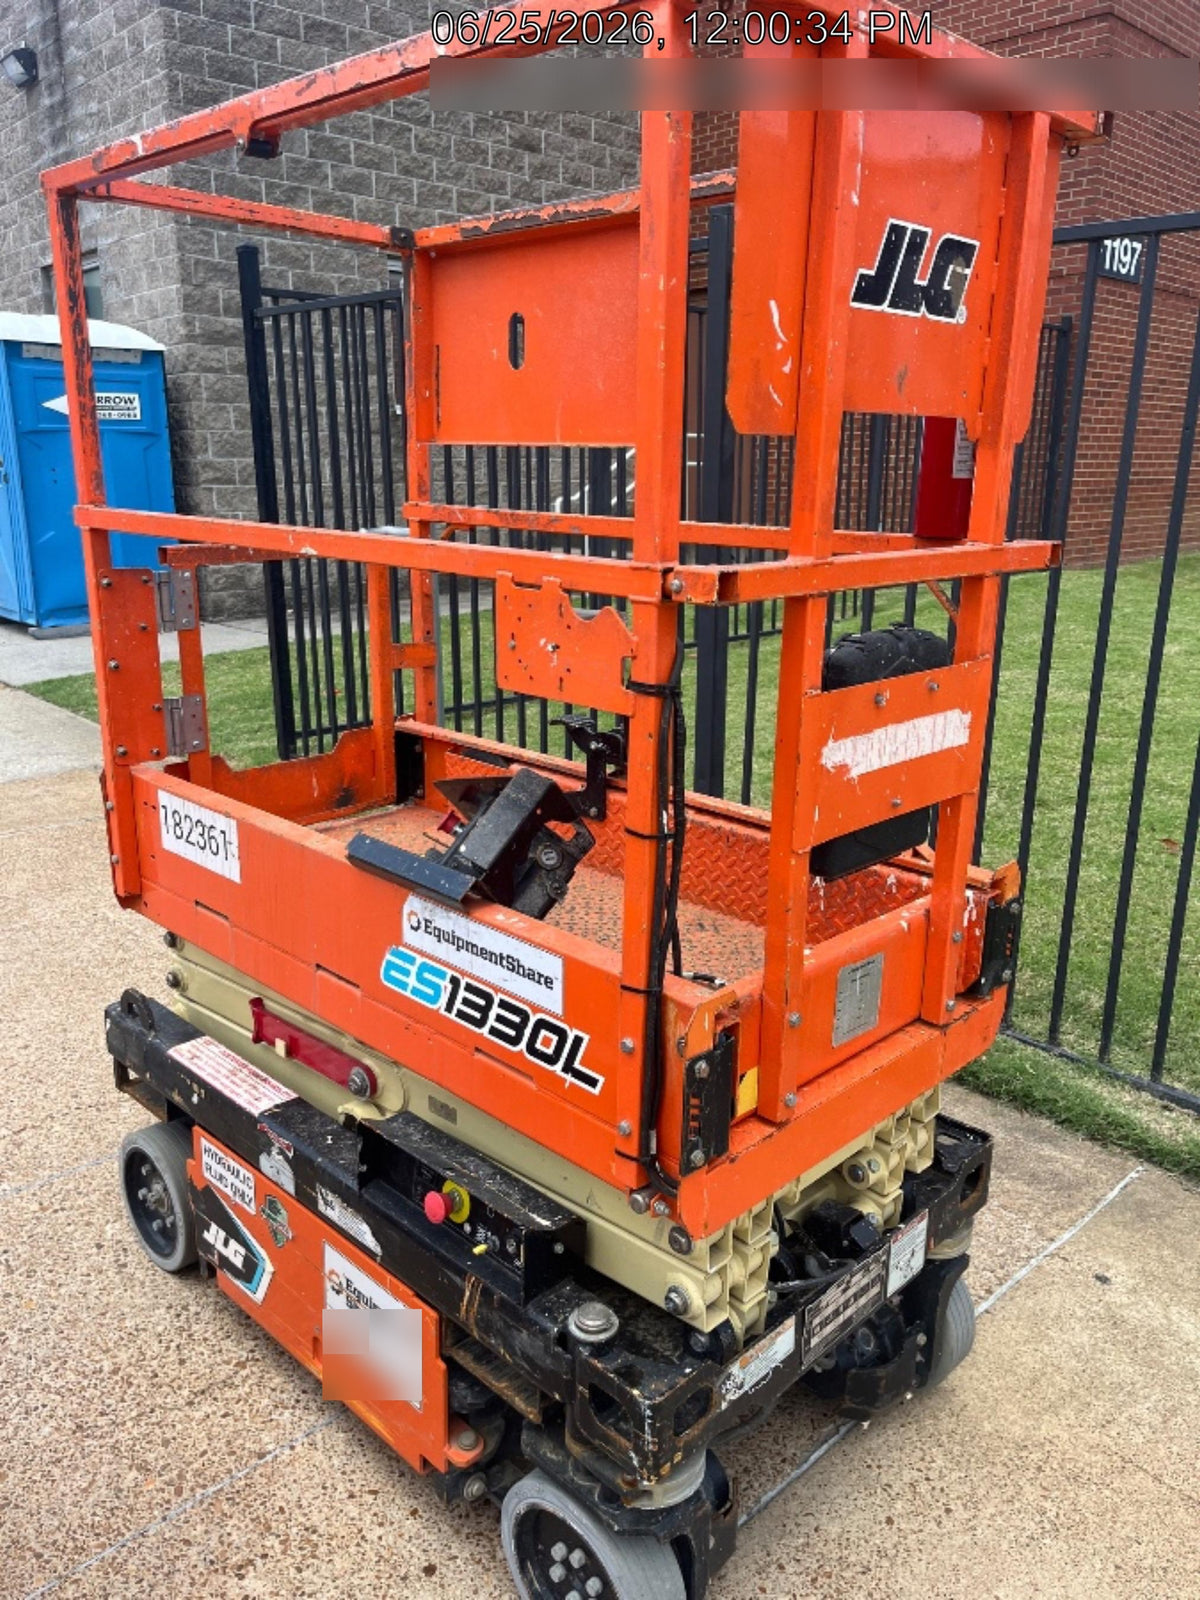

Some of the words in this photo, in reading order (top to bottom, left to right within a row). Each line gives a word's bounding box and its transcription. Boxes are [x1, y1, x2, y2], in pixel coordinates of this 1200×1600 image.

[850, 218, 980, 323] JLG
[96, 396, 136, 404] RROW
[423, 918, 555, 990] EquipmentShare
[381, 946, 601, 1091] ES1330L
[203, 1221, 246, 1269] JLG
